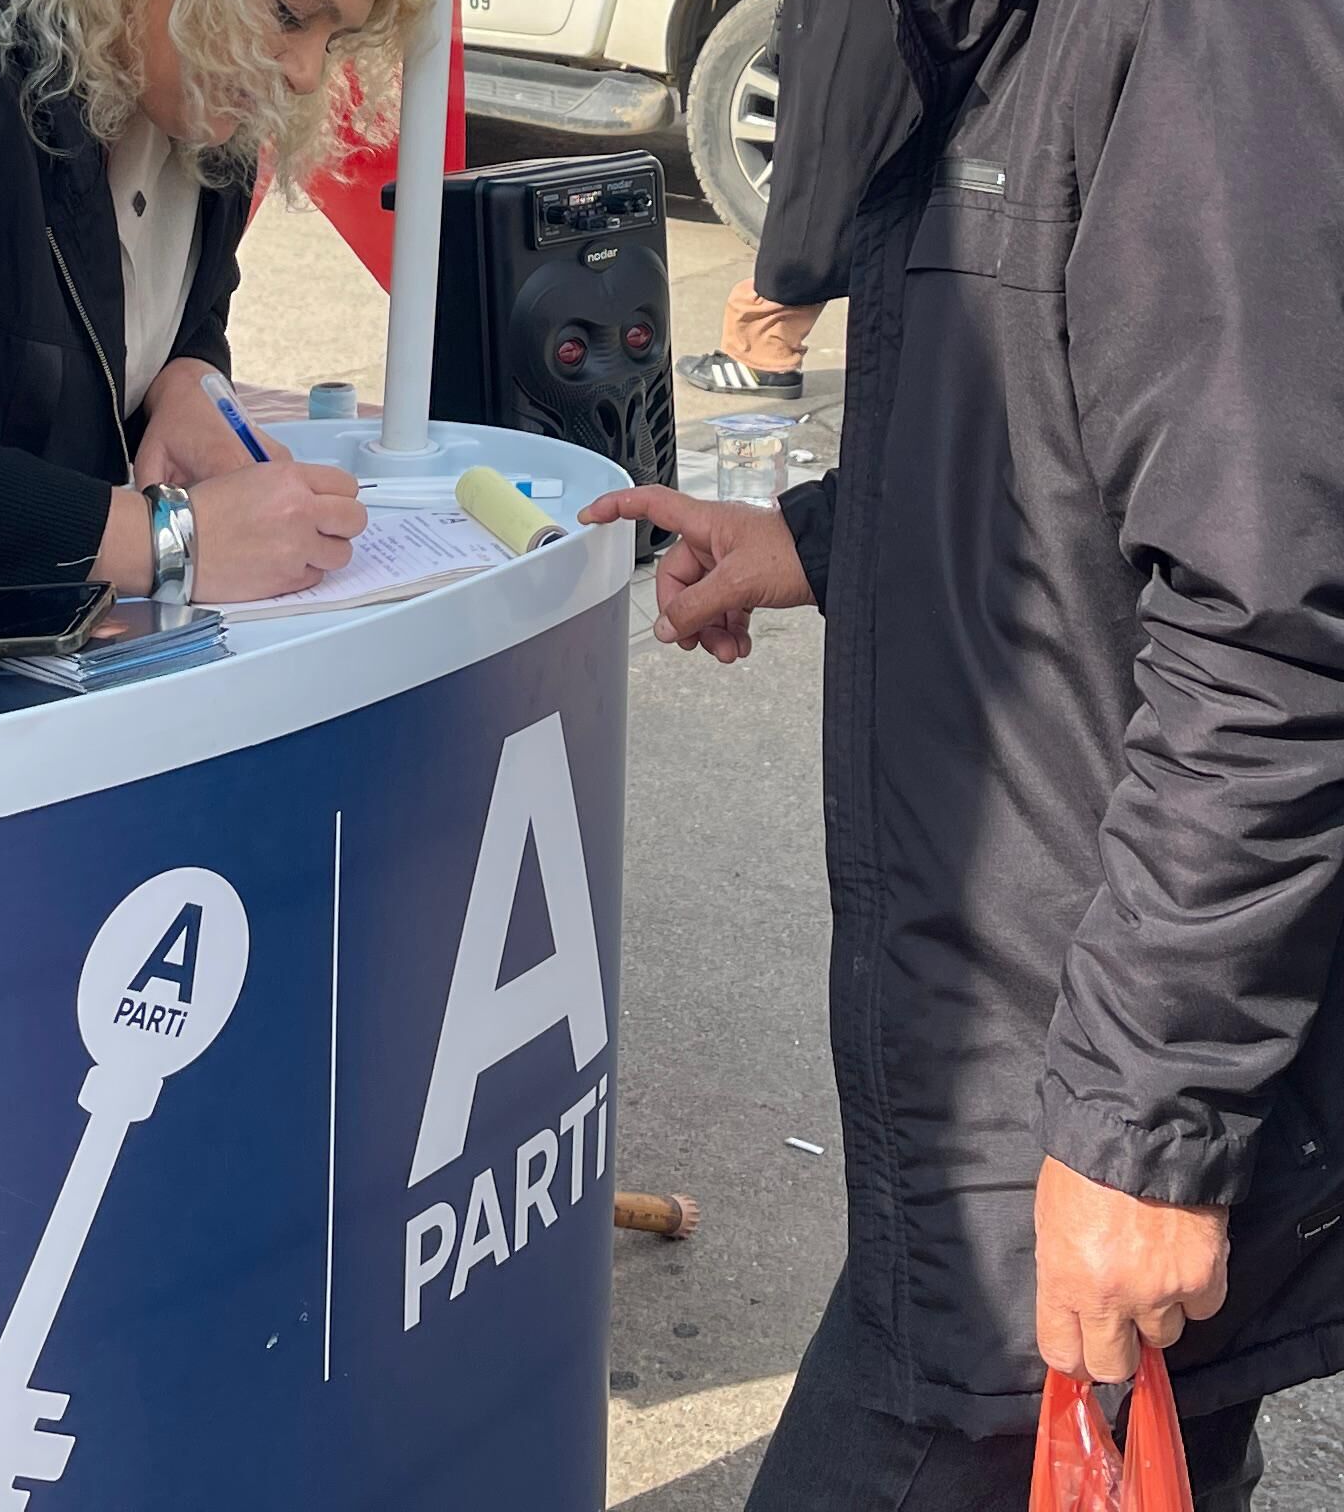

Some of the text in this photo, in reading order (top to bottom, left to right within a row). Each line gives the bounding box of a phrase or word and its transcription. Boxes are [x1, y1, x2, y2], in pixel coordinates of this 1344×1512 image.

[587, 246, 618, 262] nodar
[126, 902, 204, 1005] A
[408, 711, 609, 1189] A
